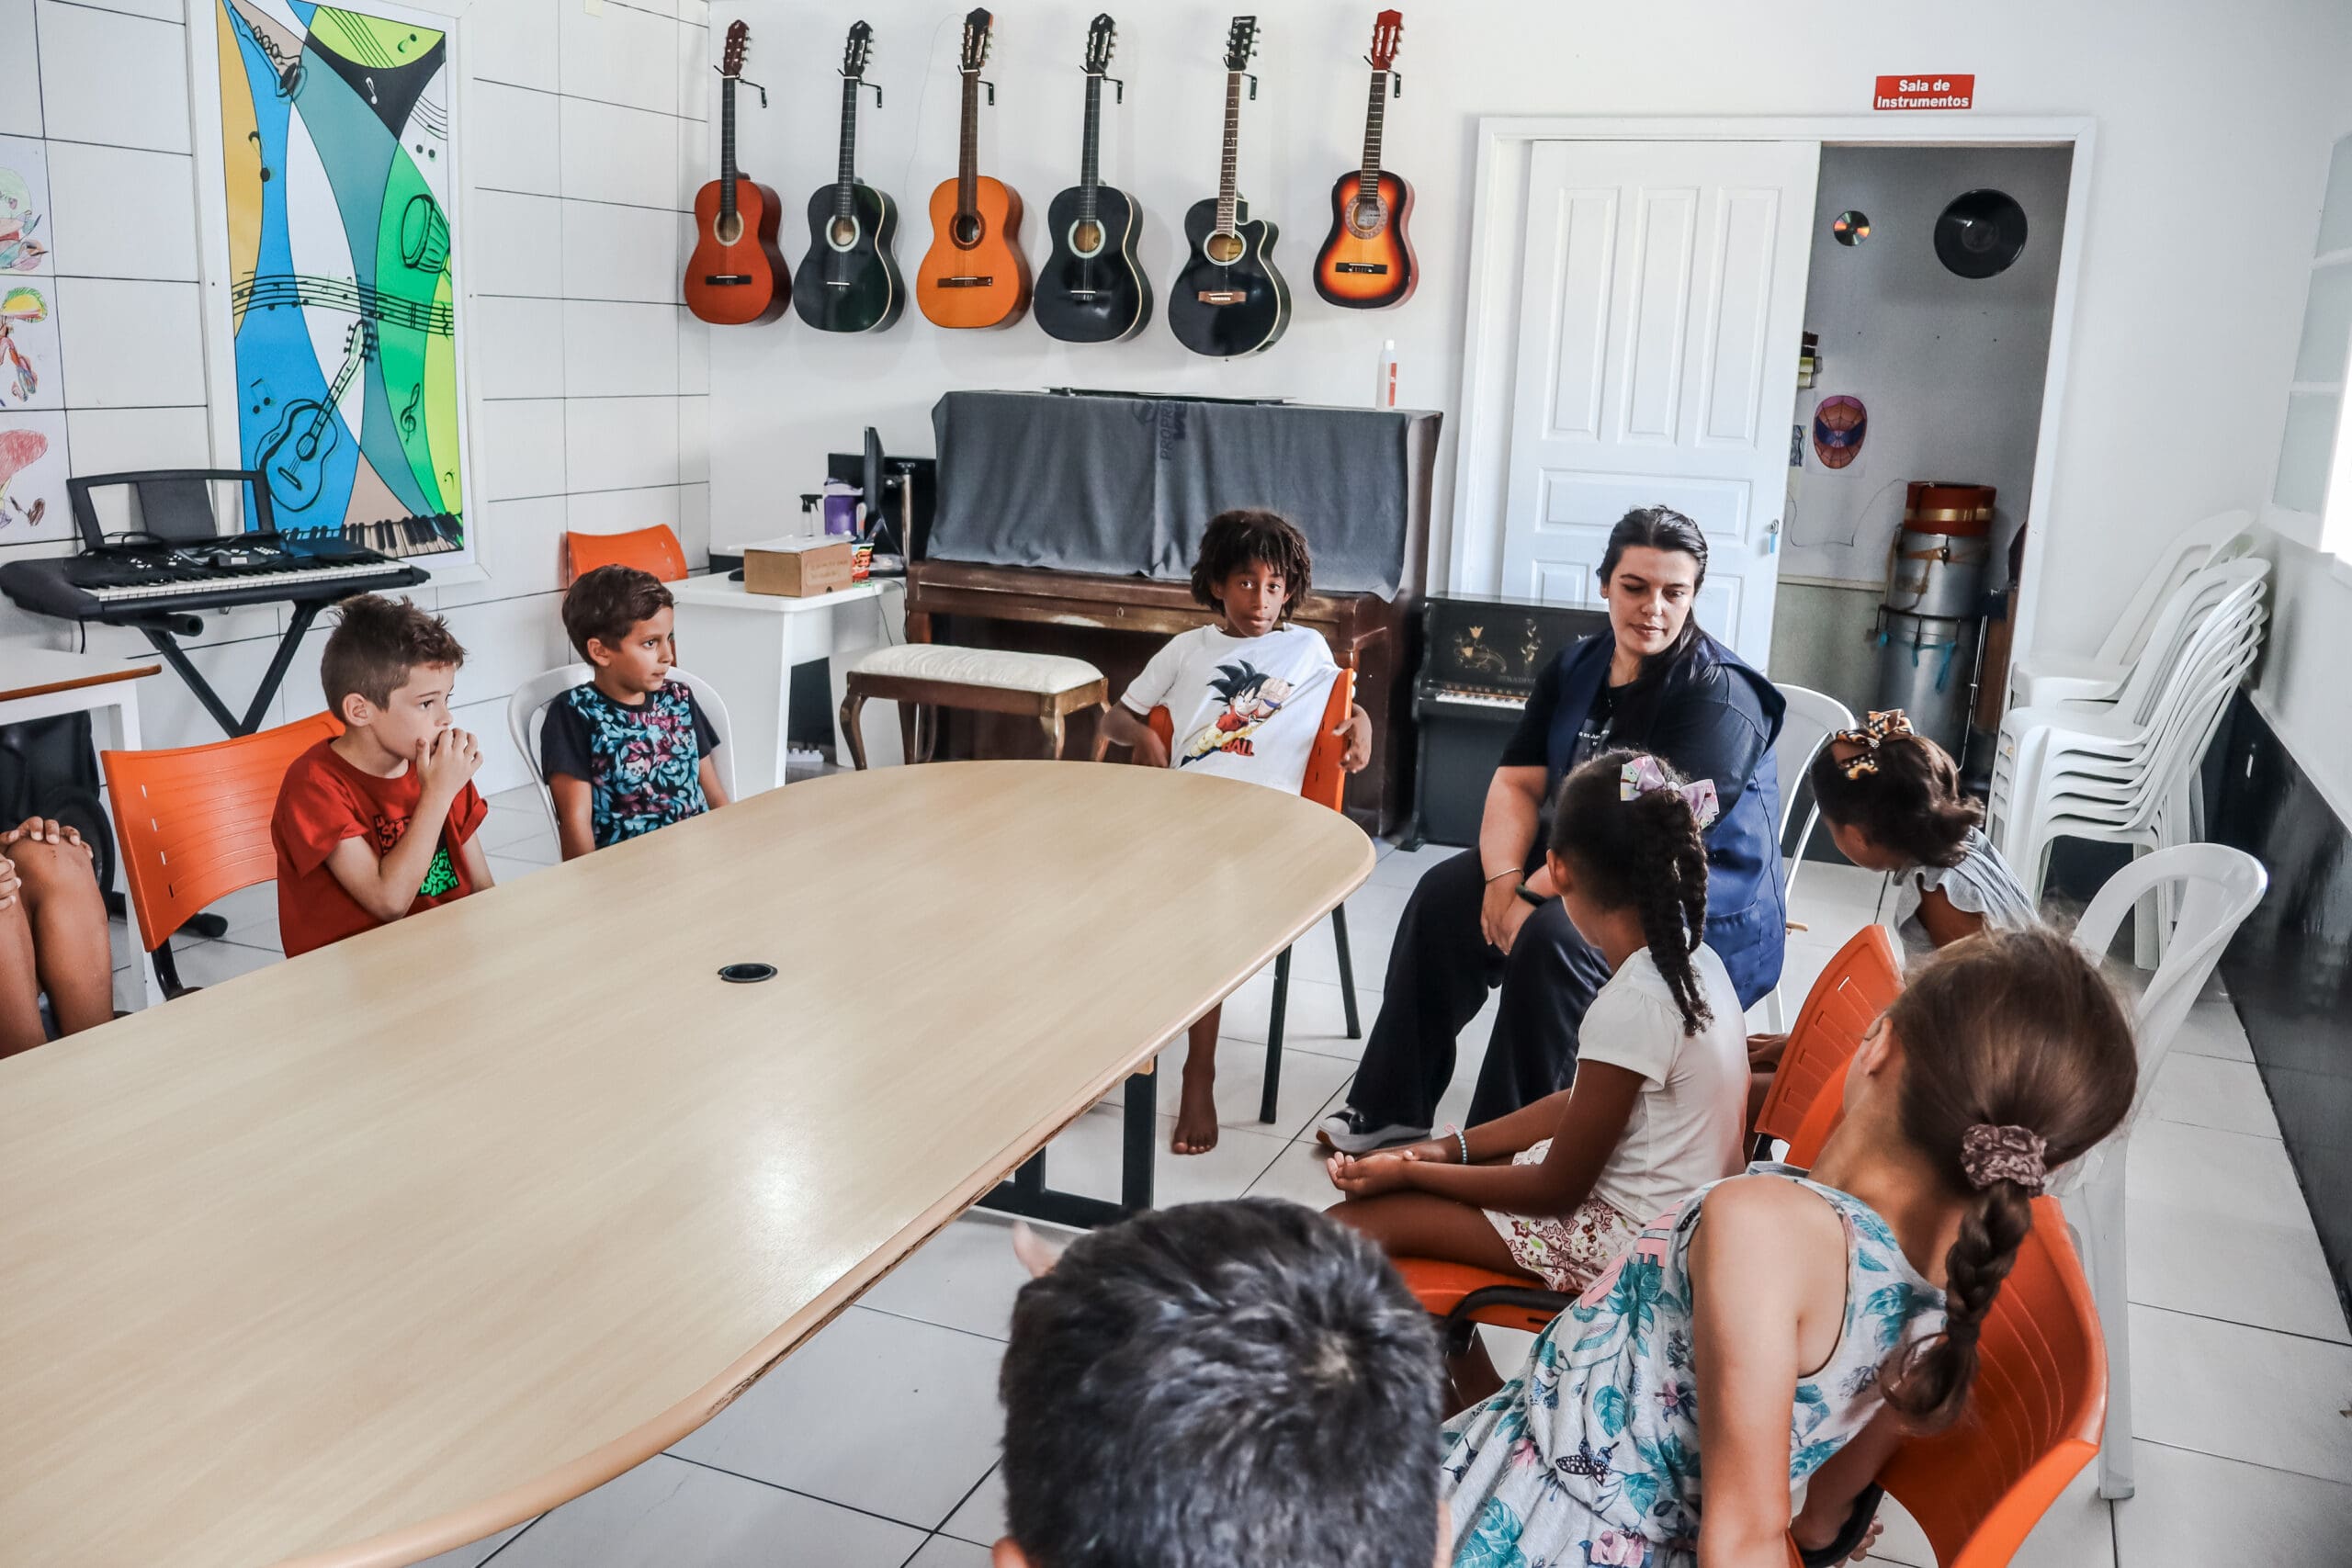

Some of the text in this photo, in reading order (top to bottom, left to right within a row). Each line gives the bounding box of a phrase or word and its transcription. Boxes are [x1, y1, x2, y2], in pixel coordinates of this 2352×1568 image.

[1898, 79, 1951, 92] Sala de
[1877, 95, 1970, 108] Instrumentos
